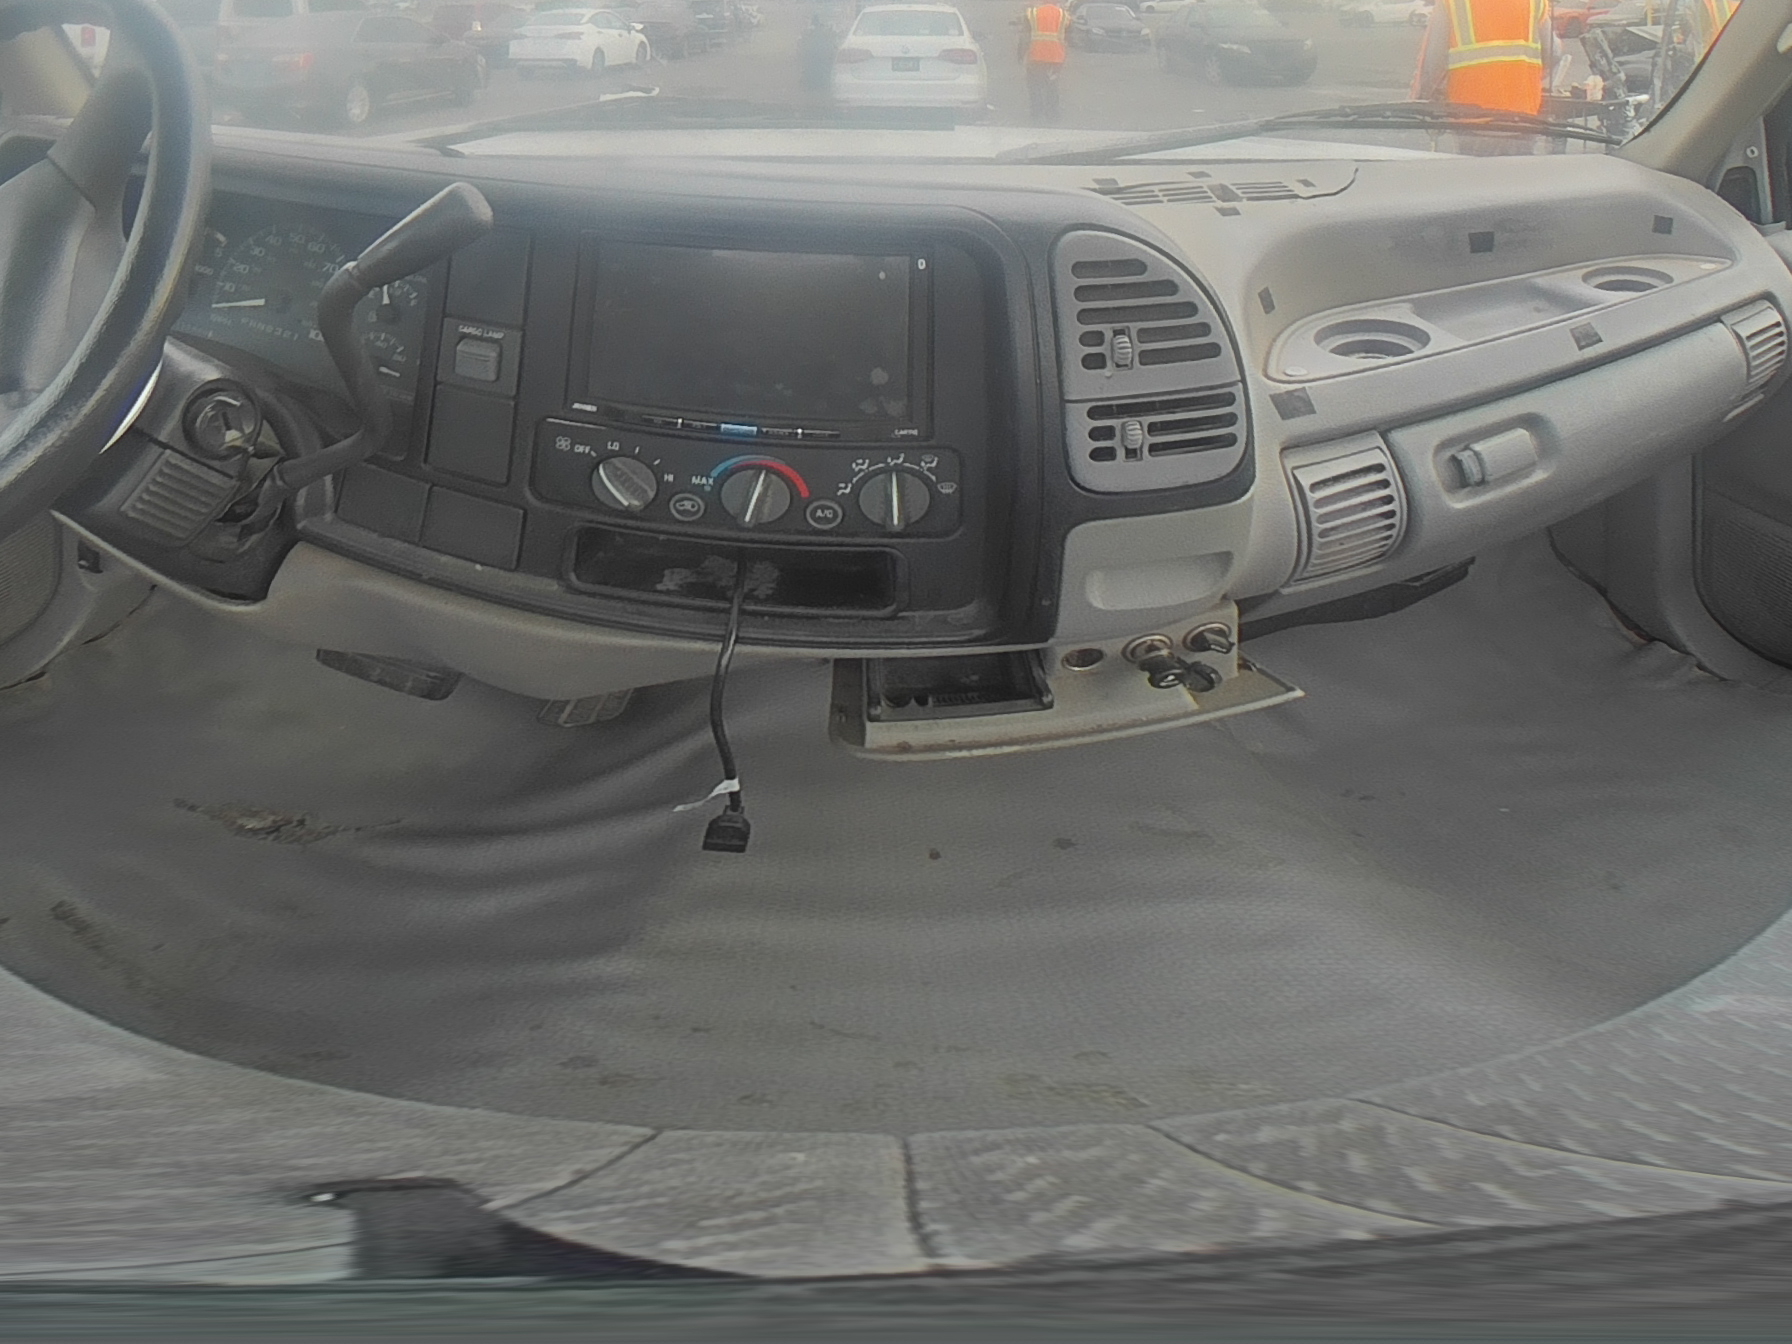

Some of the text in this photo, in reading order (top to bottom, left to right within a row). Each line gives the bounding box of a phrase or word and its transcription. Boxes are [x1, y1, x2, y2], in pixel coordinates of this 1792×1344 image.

[307, 241, 326, 254] 60
[574, 444, 590, 454] OFF
[607, 441, 620, 451] LO
[664, 474, 674, 483] HI
[691, 475, 714, 486] MAX
[815, 508, 835, 519] A/C
